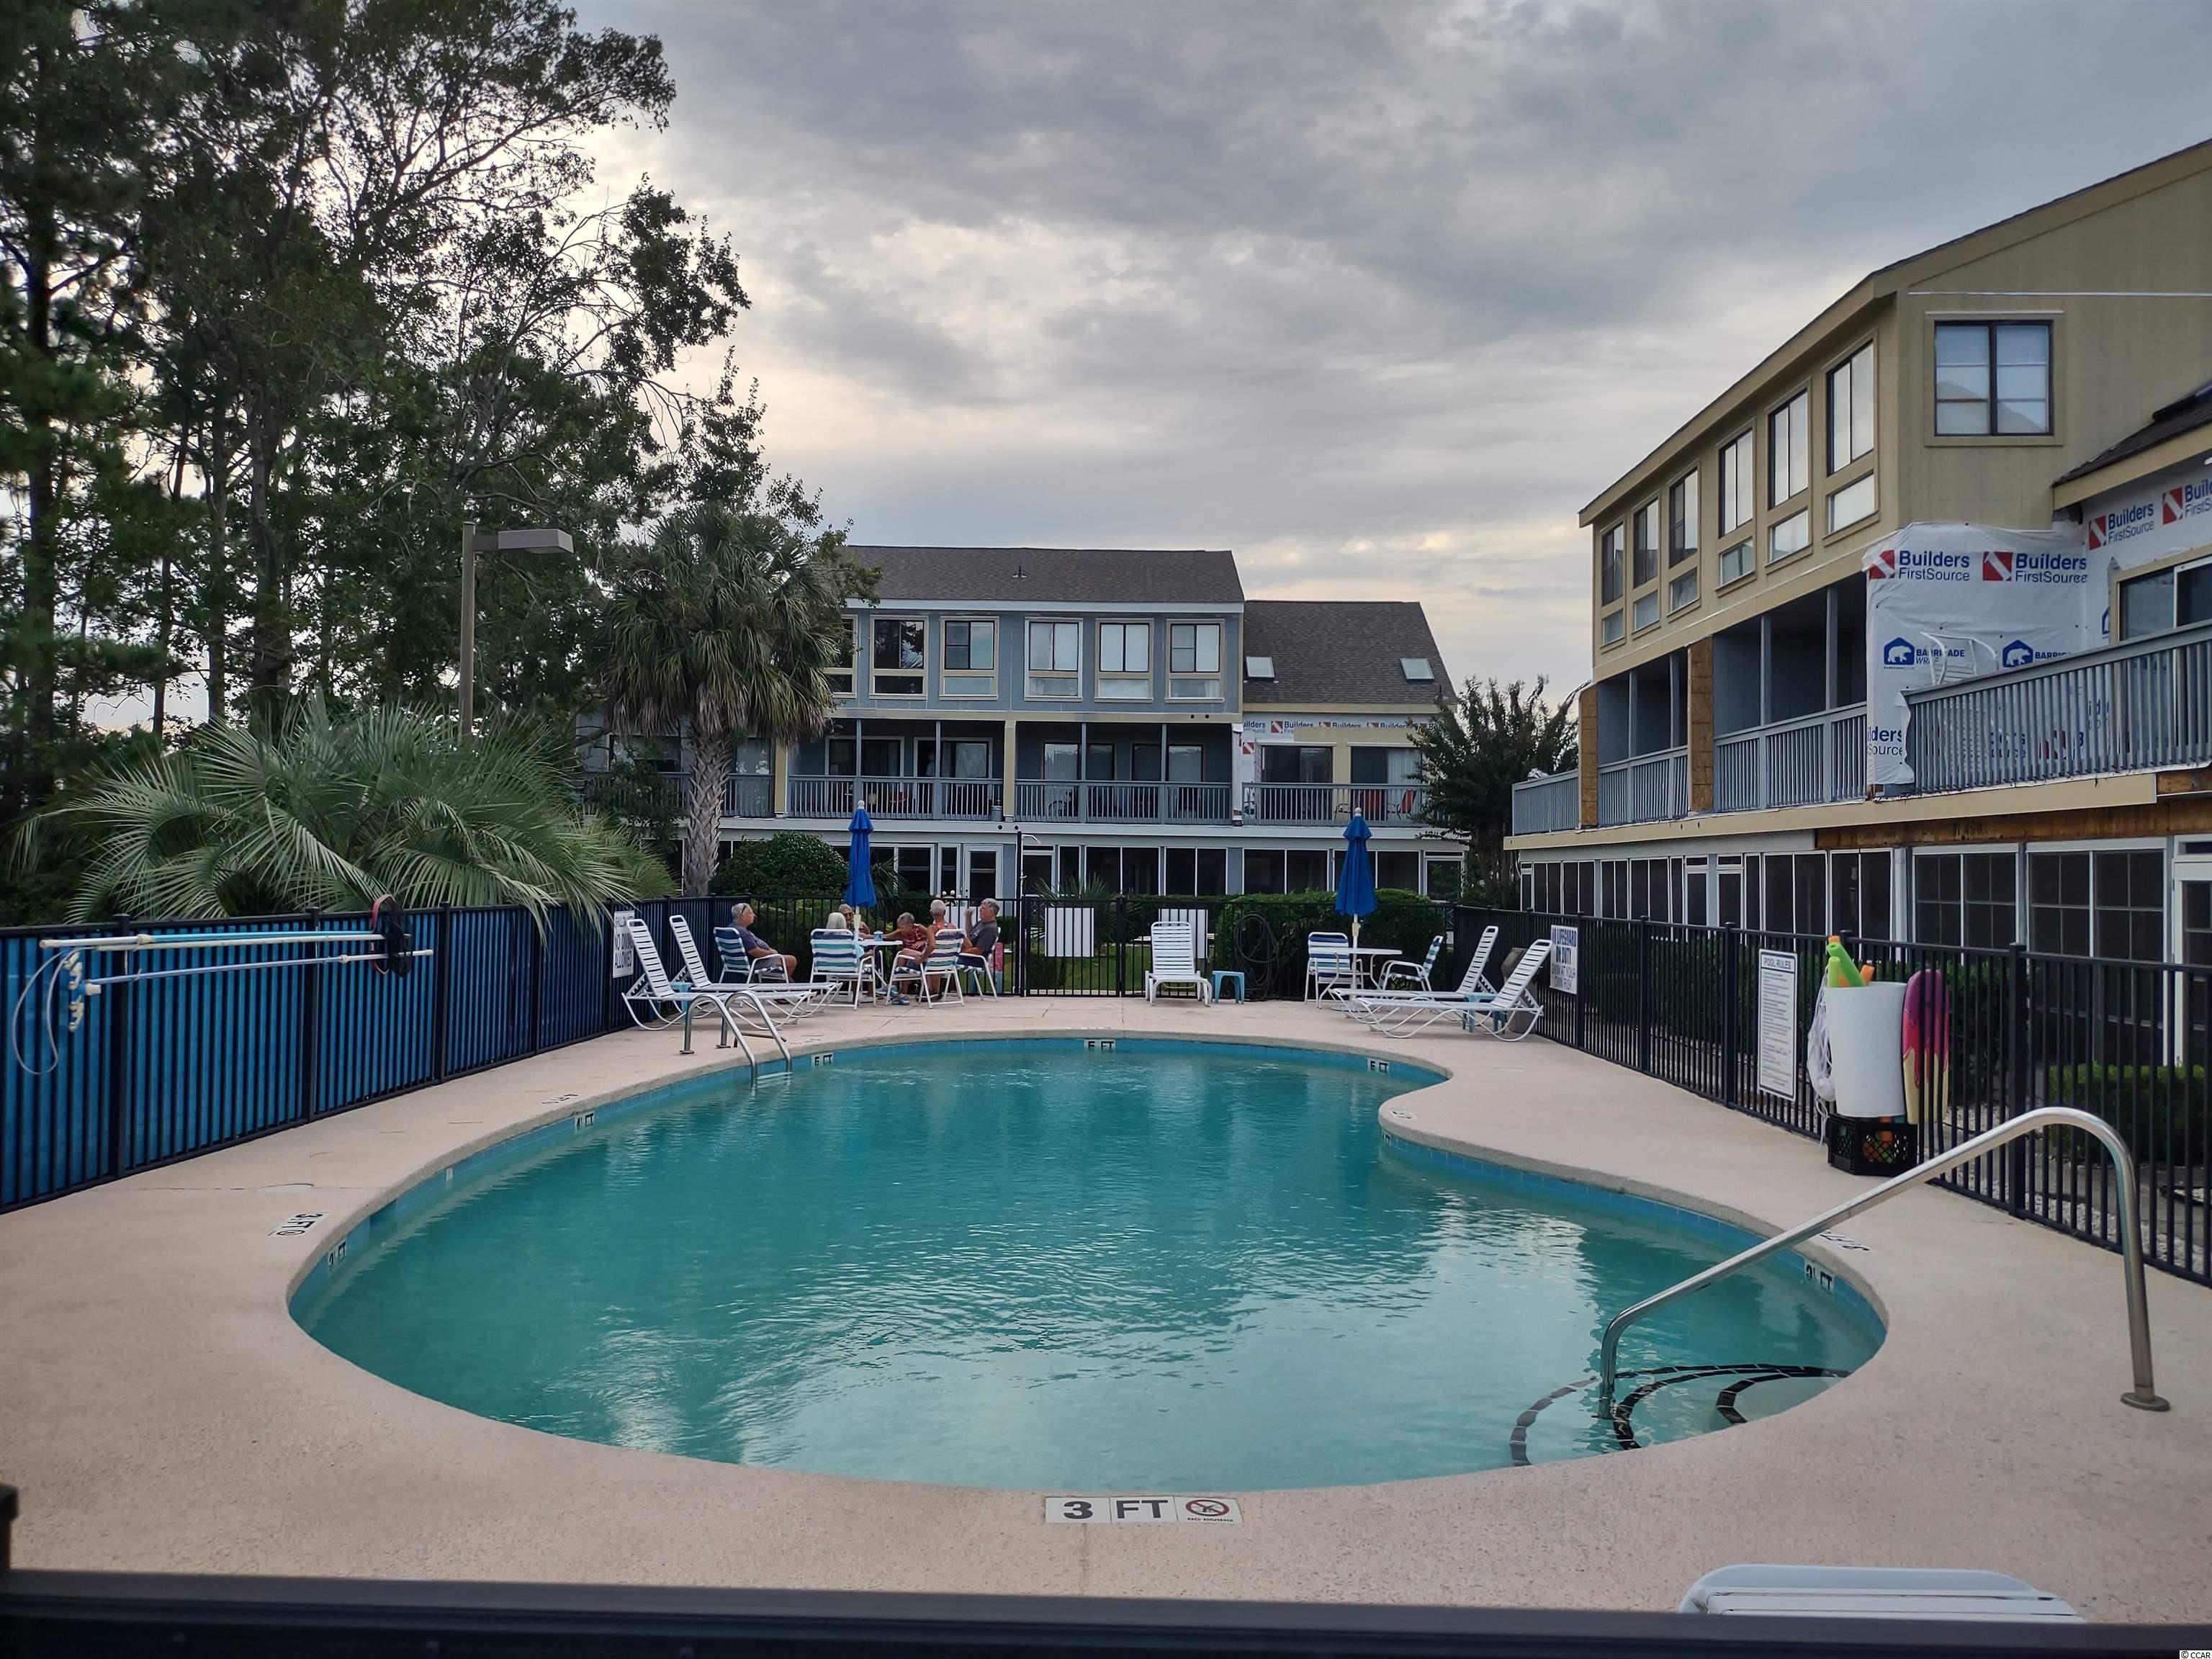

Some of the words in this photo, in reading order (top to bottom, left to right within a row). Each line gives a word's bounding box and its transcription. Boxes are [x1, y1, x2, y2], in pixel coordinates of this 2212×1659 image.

[2108, 503, 2154, 530] Builders
[2108, 521, 2154, 544] FirstSource
[1899, 550, 1970, 567] Builders
[2016, 552, 2087, 570] Builders
[1899, 567, 1970, 581] FirstSource
[2016, 570, 2087, 584] FirstSource
[1764, 957, 1776, 967] POOL
[1776, 959, 1791, 970] RULES
[1064, 1501, 1093, 1519] 3
[1116, 1499, 1169, 1519] FT
